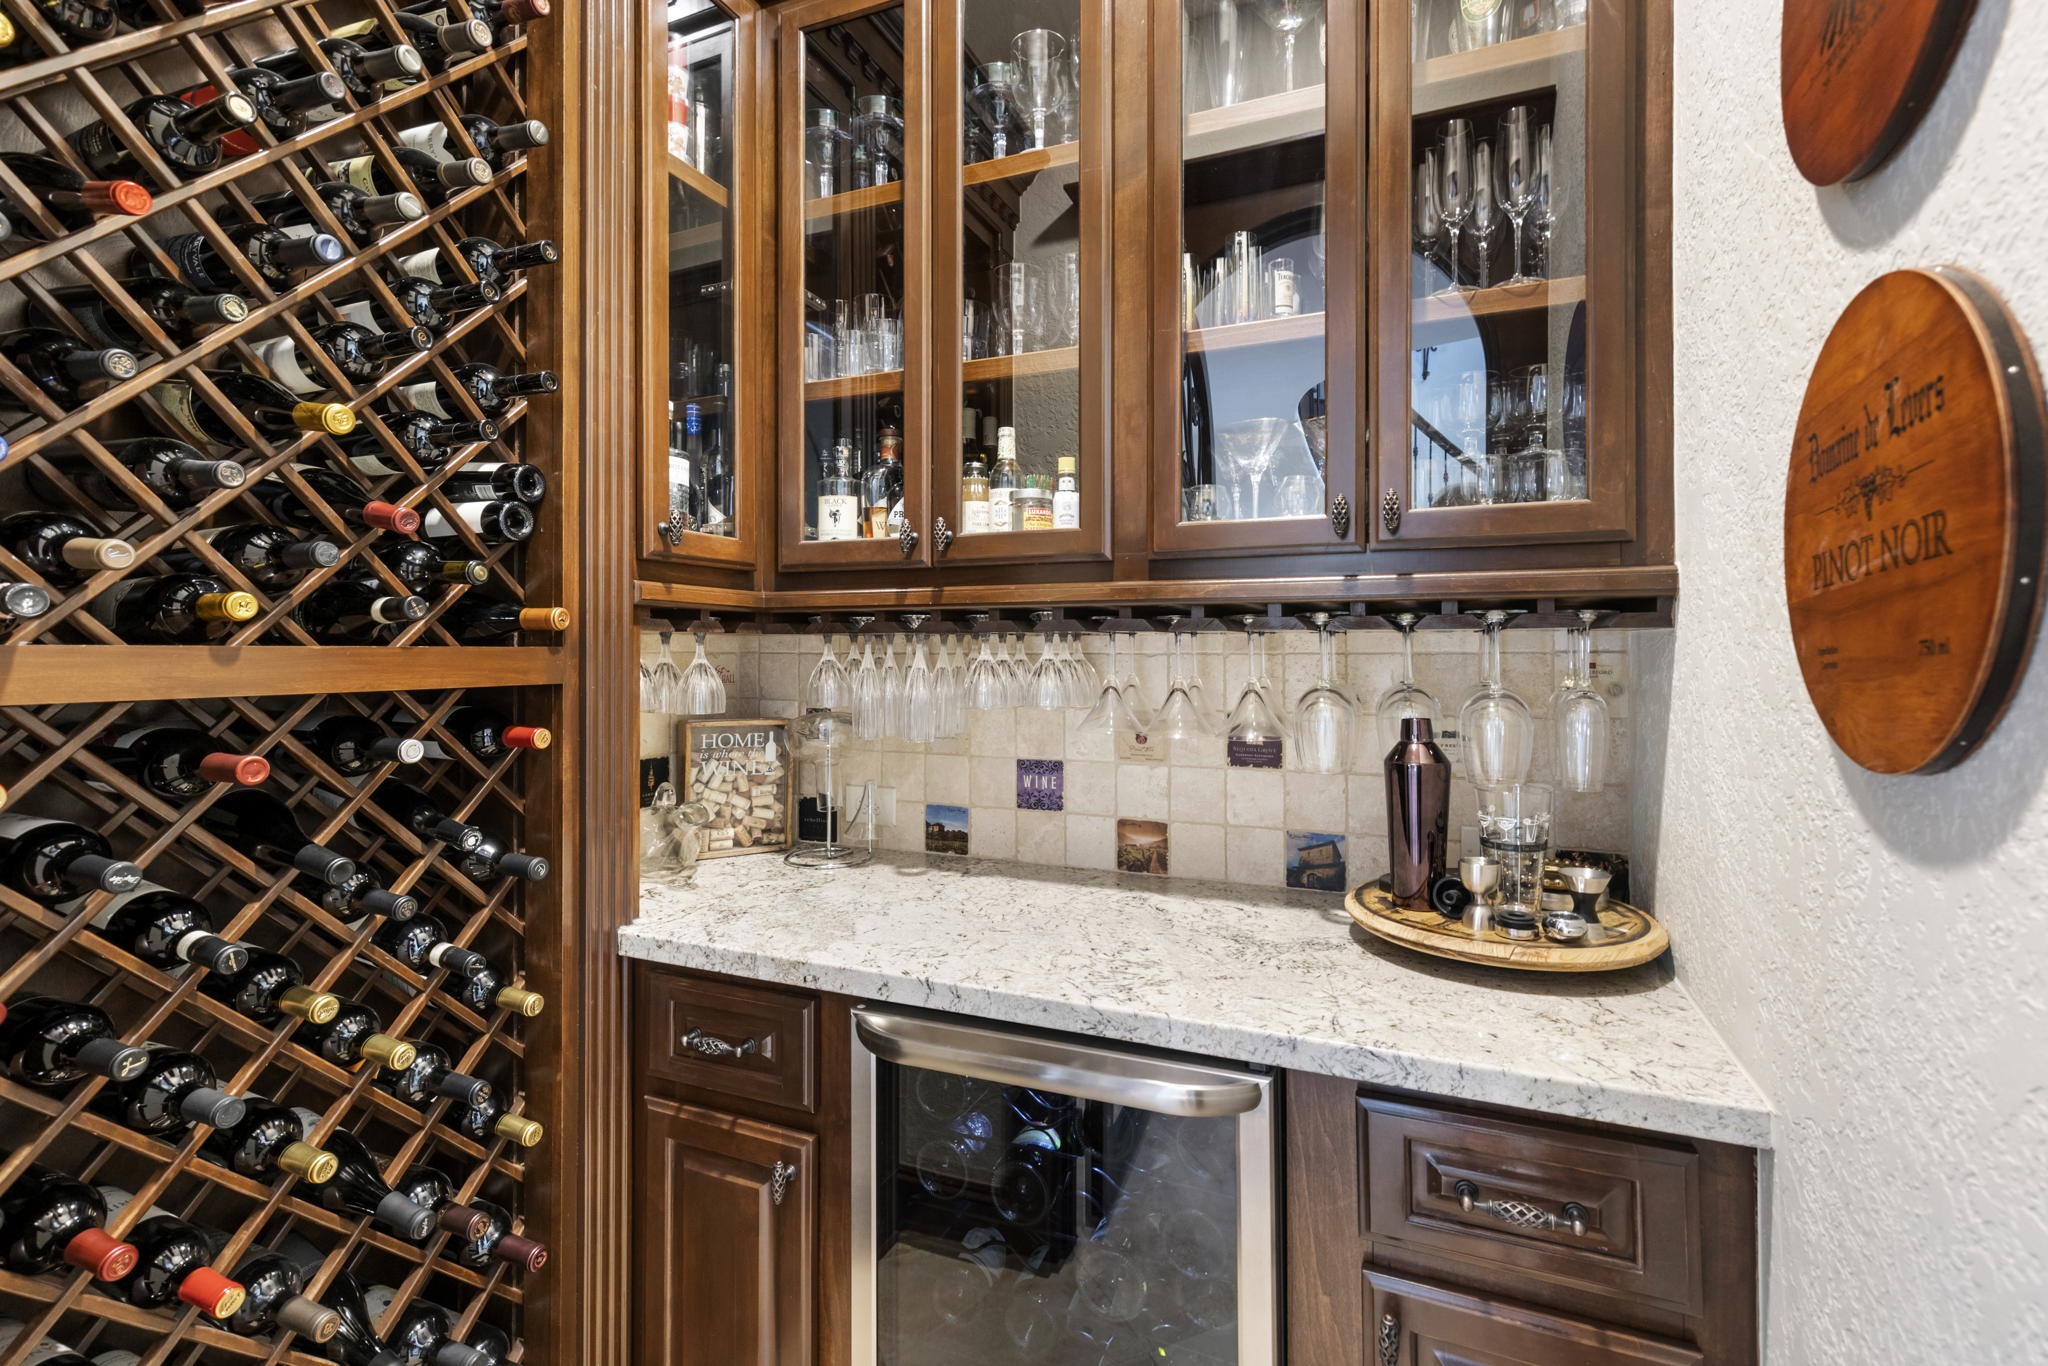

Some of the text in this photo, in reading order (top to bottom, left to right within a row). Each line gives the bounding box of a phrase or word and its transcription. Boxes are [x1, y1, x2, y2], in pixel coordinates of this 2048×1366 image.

[1811, 509, 1953, 591] PINOT NOIR
[700, 731, 765, 749] HOME
[699, 749, 709, 759] is
[700, 760, 765, 777] WINE
[1023, 774, 1057, 790] WINE
